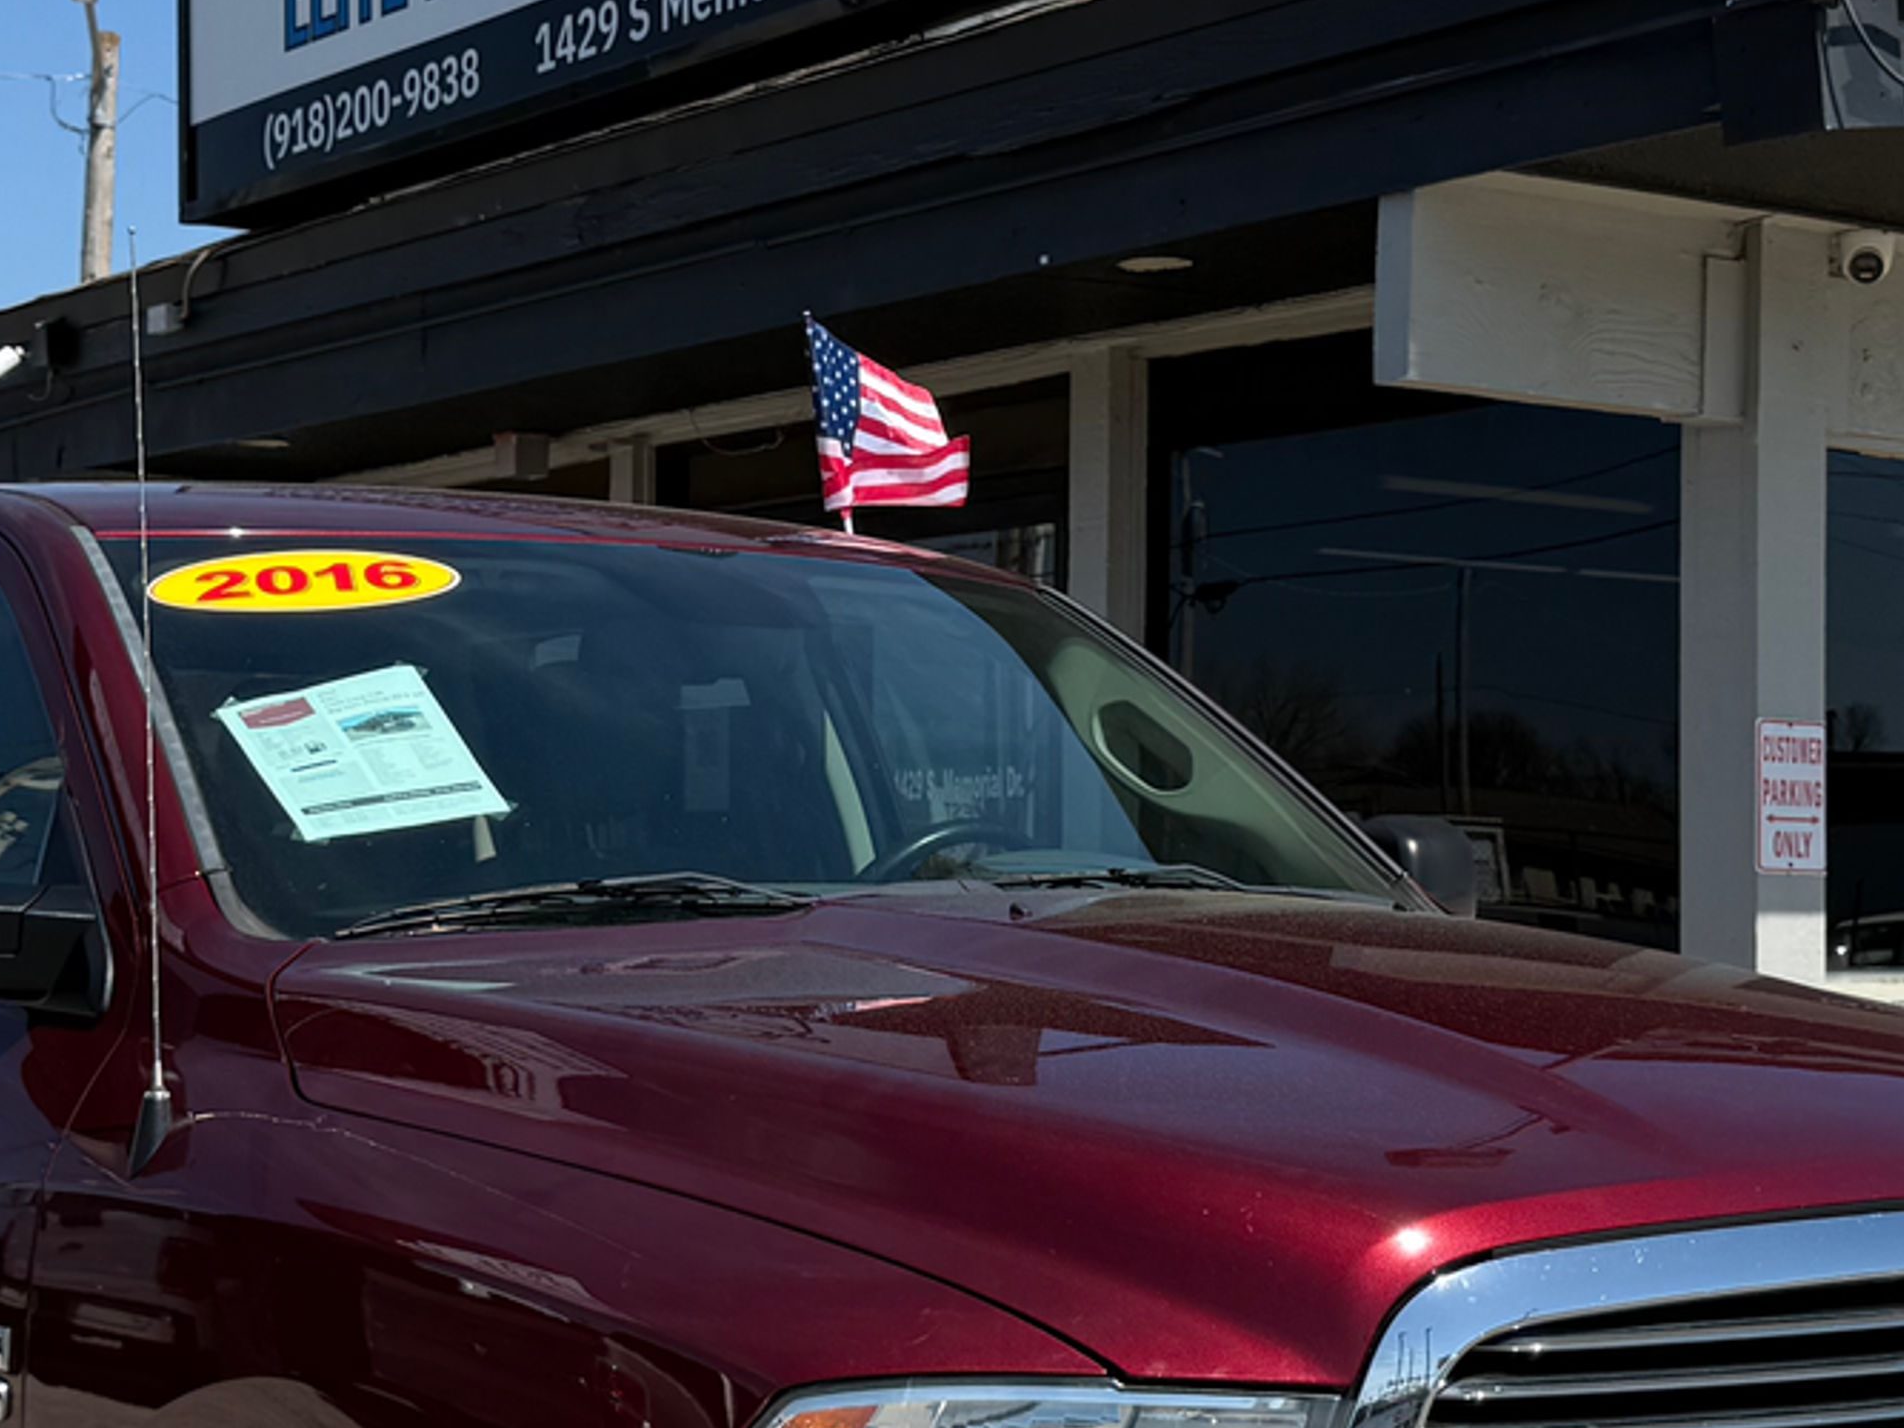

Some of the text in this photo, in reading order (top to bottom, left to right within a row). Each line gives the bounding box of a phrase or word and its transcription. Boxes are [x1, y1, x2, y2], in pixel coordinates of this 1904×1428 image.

[262, 48, 482, 171] (918)200-9838
[195, 561, 419, 602] 2016
[1762, 735, 1822, 764] CUSTOMER
[1762, 778, 1822, 807] PARKING
[1772, 830, 1814, 859] ONLY
